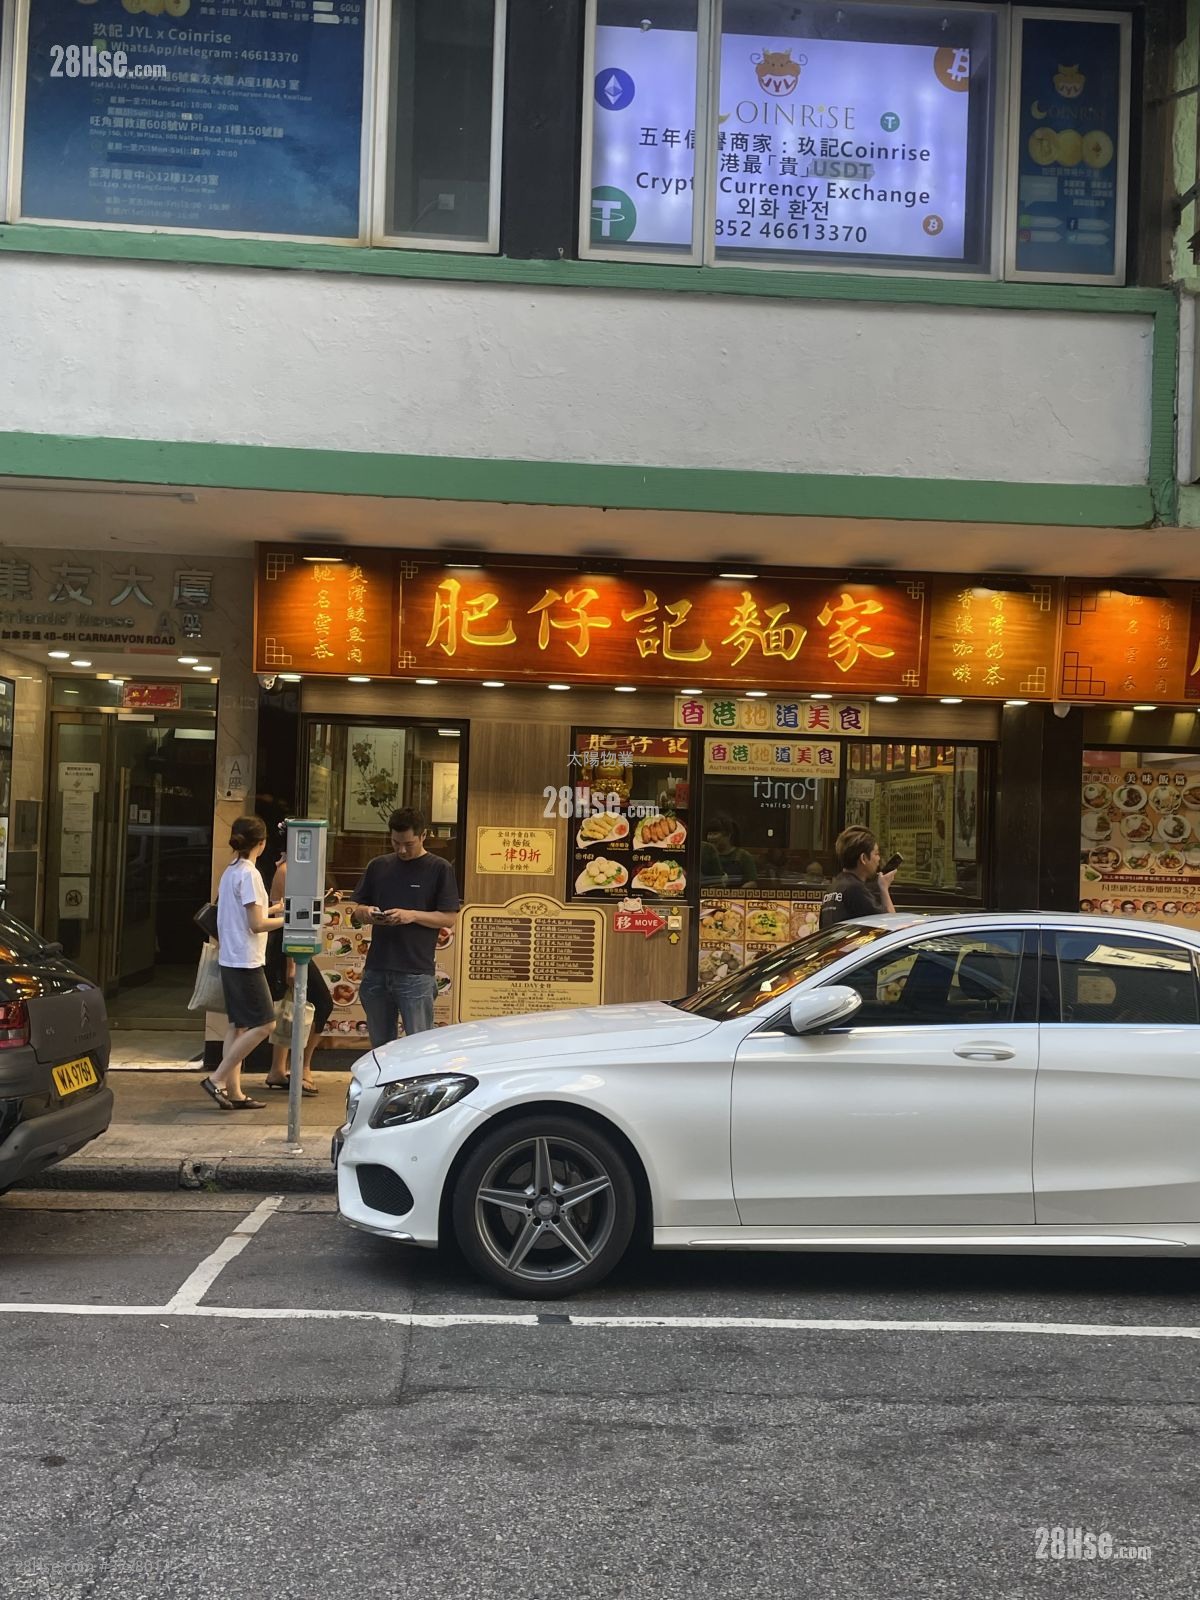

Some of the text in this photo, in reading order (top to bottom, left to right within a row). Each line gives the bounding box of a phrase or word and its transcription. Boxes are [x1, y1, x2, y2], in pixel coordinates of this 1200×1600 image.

[127, 25, 152, 39] JYL
[157, 30, 165, 40] x
[168, 29, 232, 45] Coinrise
[241, 49, 299, 63] 46613370
[191, 123, 221, 134] Plaza
[637, 172, 930, 208] Crypt Currency Exchange
[737, 198, 829, 221] 외화 환전
[760, 222, 867, 242] 46613370
[425, 578, 895, 673] 肥仔記麵家
[79, 632, 143, 644] CARNARVON
[145, 635, 175, 645] ROAD
[682, 700, 861, 730] 香港地道美食
[711, 744, 834, 764] 香港地道美食
[489, 848, 541, 863] 一律9折
[616, 916, 658, 929] 移 MOVE
